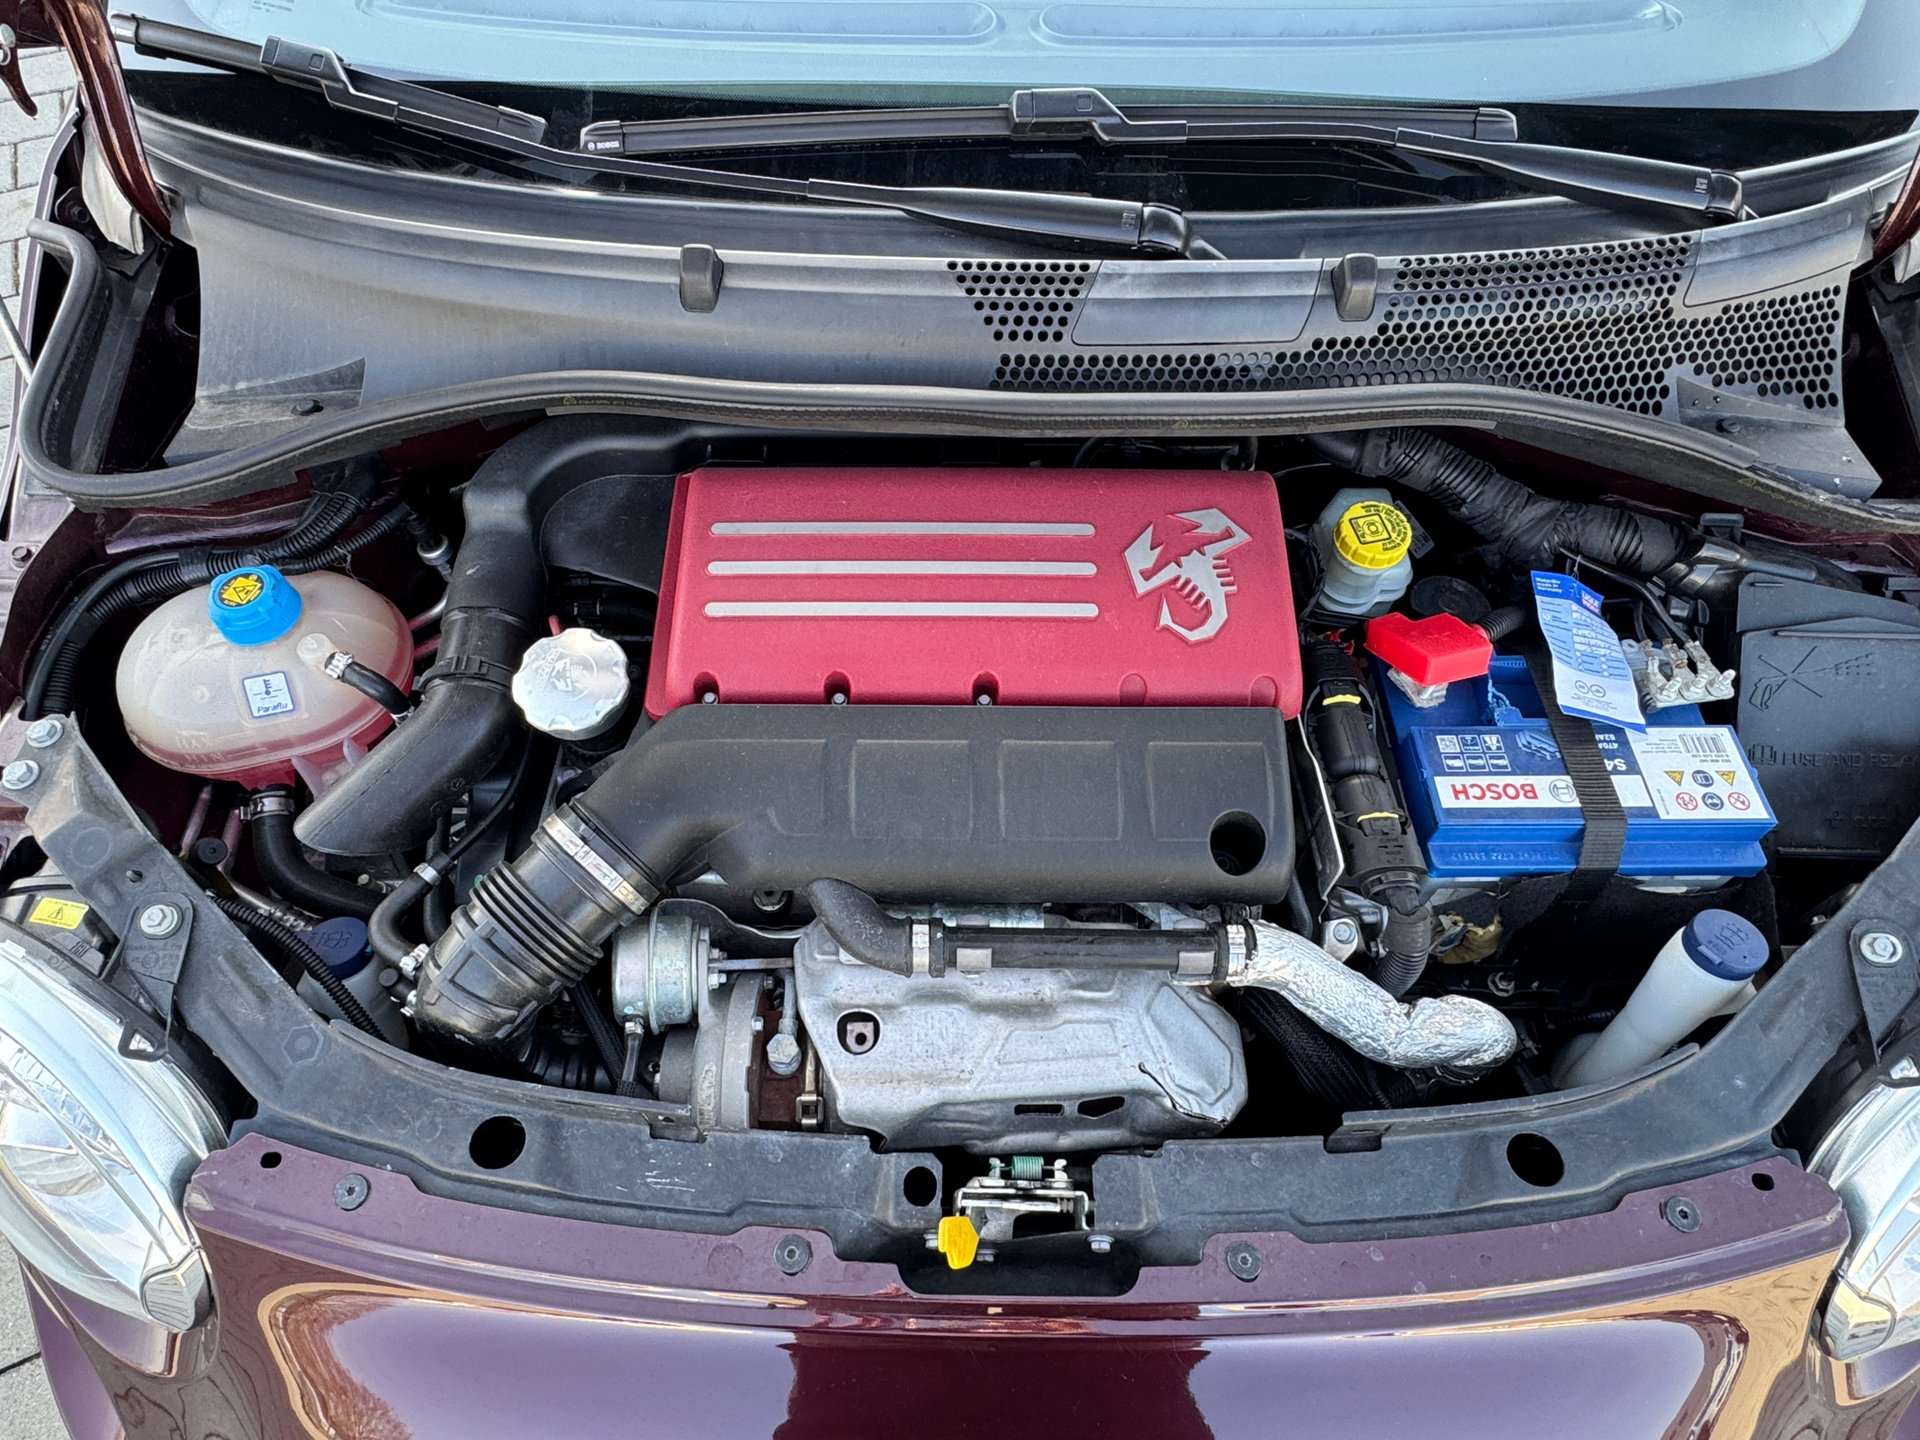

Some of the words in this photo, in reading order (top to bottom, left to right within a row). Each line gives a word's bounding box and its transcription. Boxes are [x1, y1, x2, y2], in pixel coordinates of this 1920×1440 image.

[257, 702, 288, 714] Paraflu
[1604, 758, 1627, 771] S4
[1782, 752, 1822, 767] FUSE
[1831, 752, 1861, 768] AND
[1450, 783, 1539, 800] BOSCH
